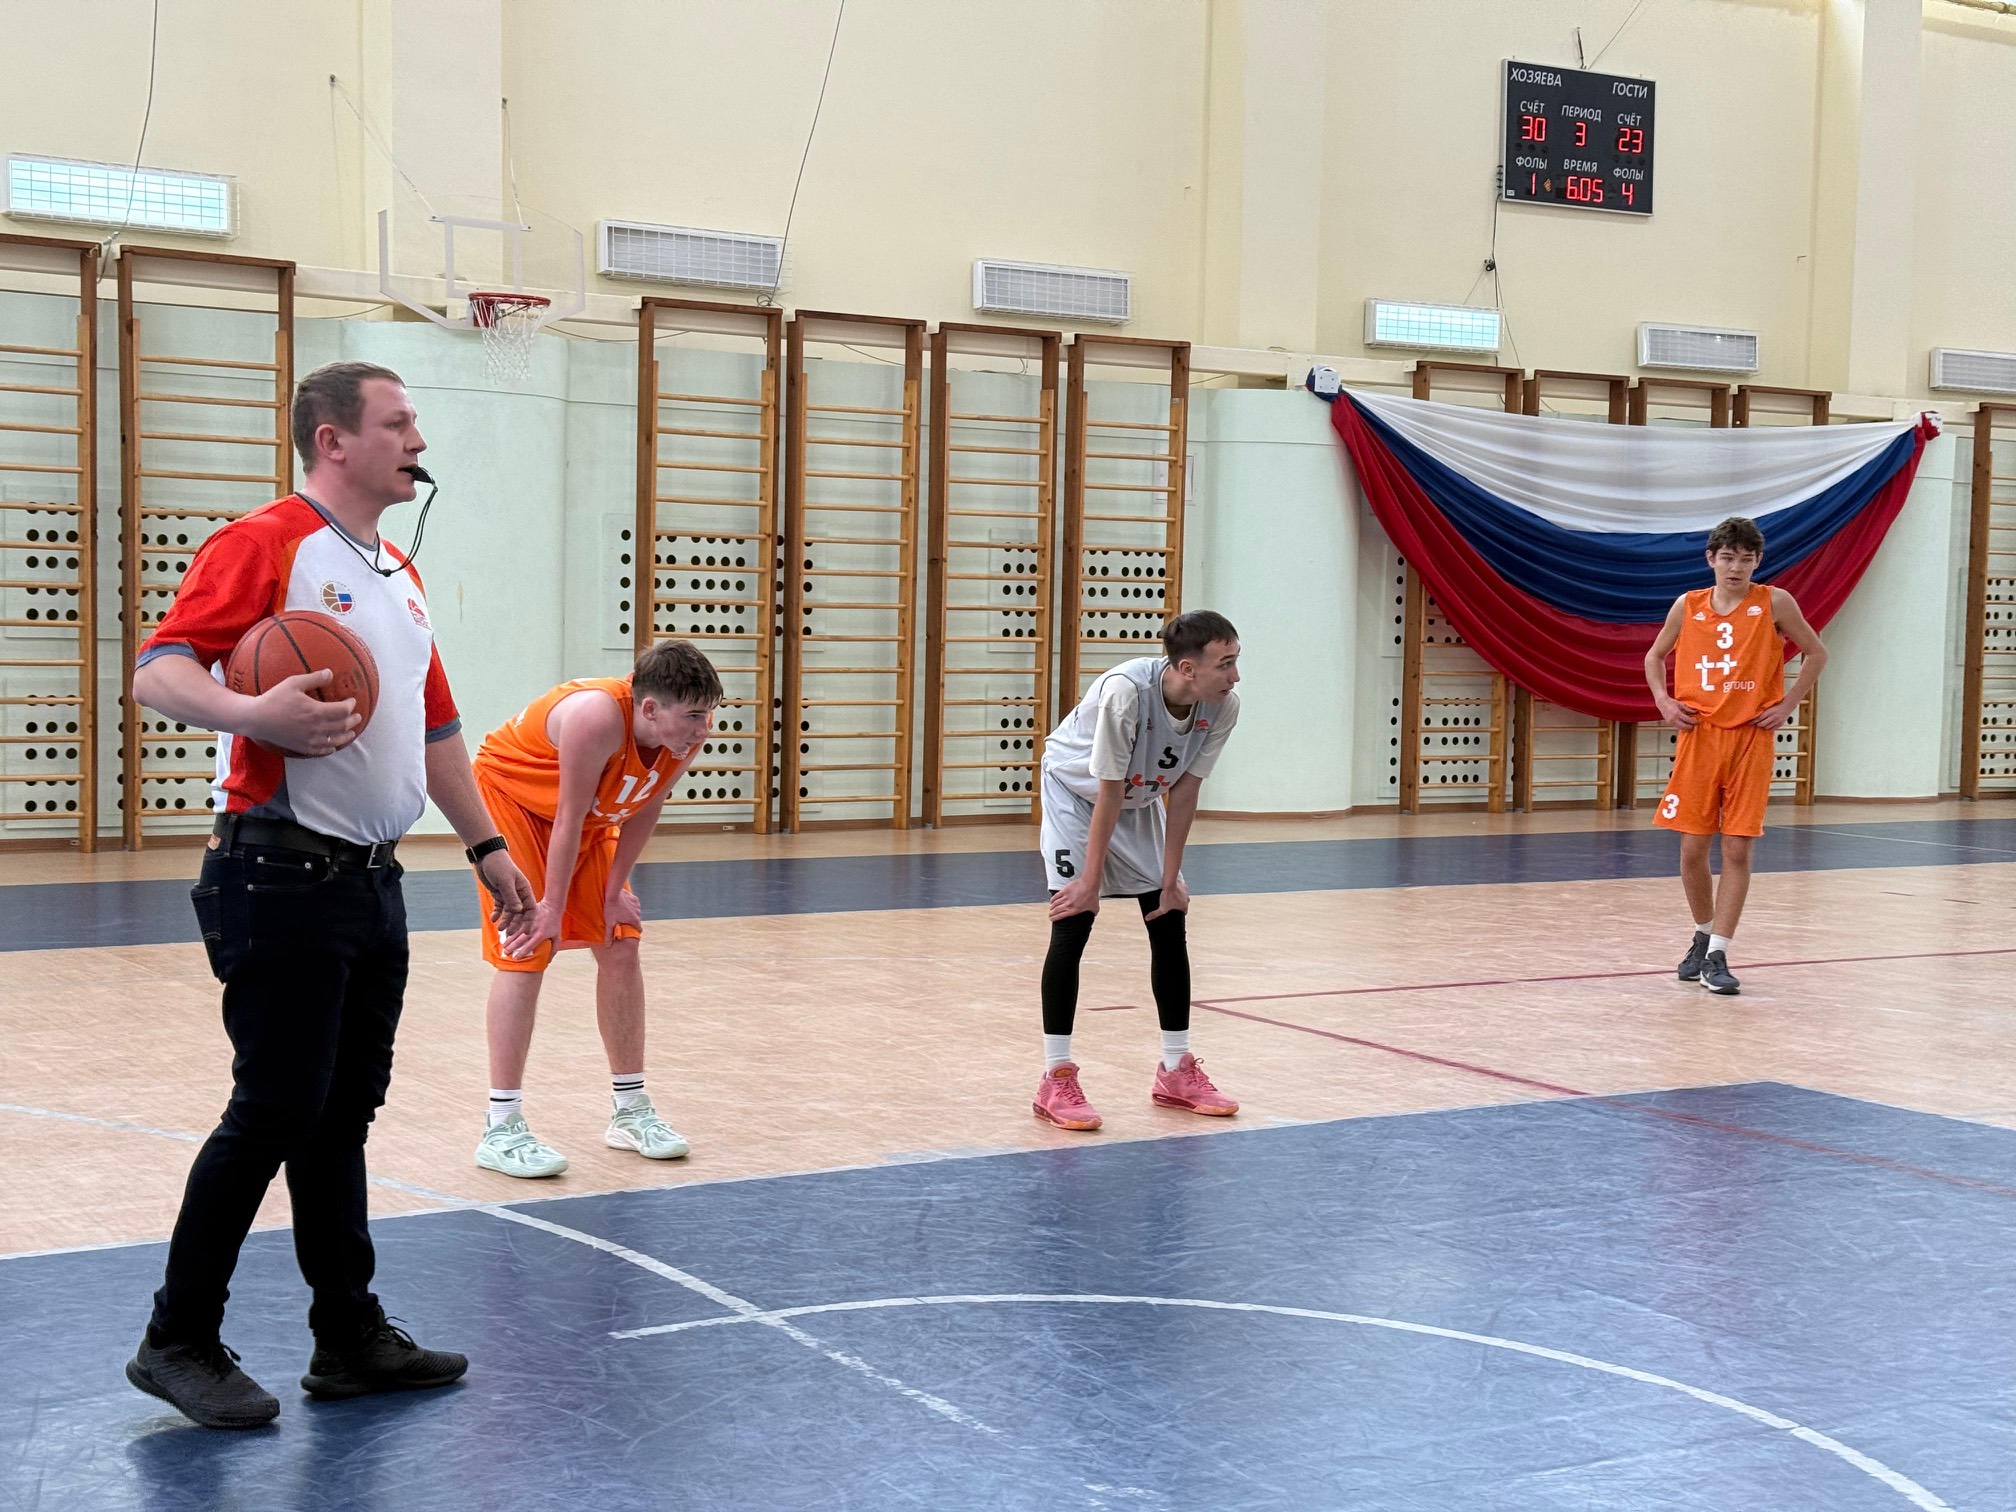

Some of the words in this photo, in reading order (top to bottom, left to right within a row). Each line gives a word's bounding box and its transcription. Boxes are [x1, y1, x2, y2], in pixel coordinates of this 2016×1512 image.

[1510, 68, 1562, 87] ХОЗЯЕВА
[1612, 82, 1647, 98] ГОСТИ
[1520, 100, 1545, 114] СЧЁТ
[1562, 105, 1602, 122] ПЕРИОД
[1522, 116, 1547, 141] 30
[1618, 113, 1641, 126] СЧЁТ
[1575, 122, 1586, 146] 3
[1618, 128, 1643, 153] 23
[1516, 156, 1547, 169] ФОЛЫ
[1564, 159, 1597, 173] ВРЕМЯ
[1613, 168, 1644, 180] ФОЛЫ
[1531, 172, 1536, 195] 1
[1622, 182, 1634, 205] 4
[1716, 622, 1734, 649] 3
[1722, 680, 1755, 693] group
[1158, 746, 1179, 769] 5
[615, 770, 659, 804] 12
[1662, 794, 1680, 819] 3
[1055, 849, 1075, 878] 5
